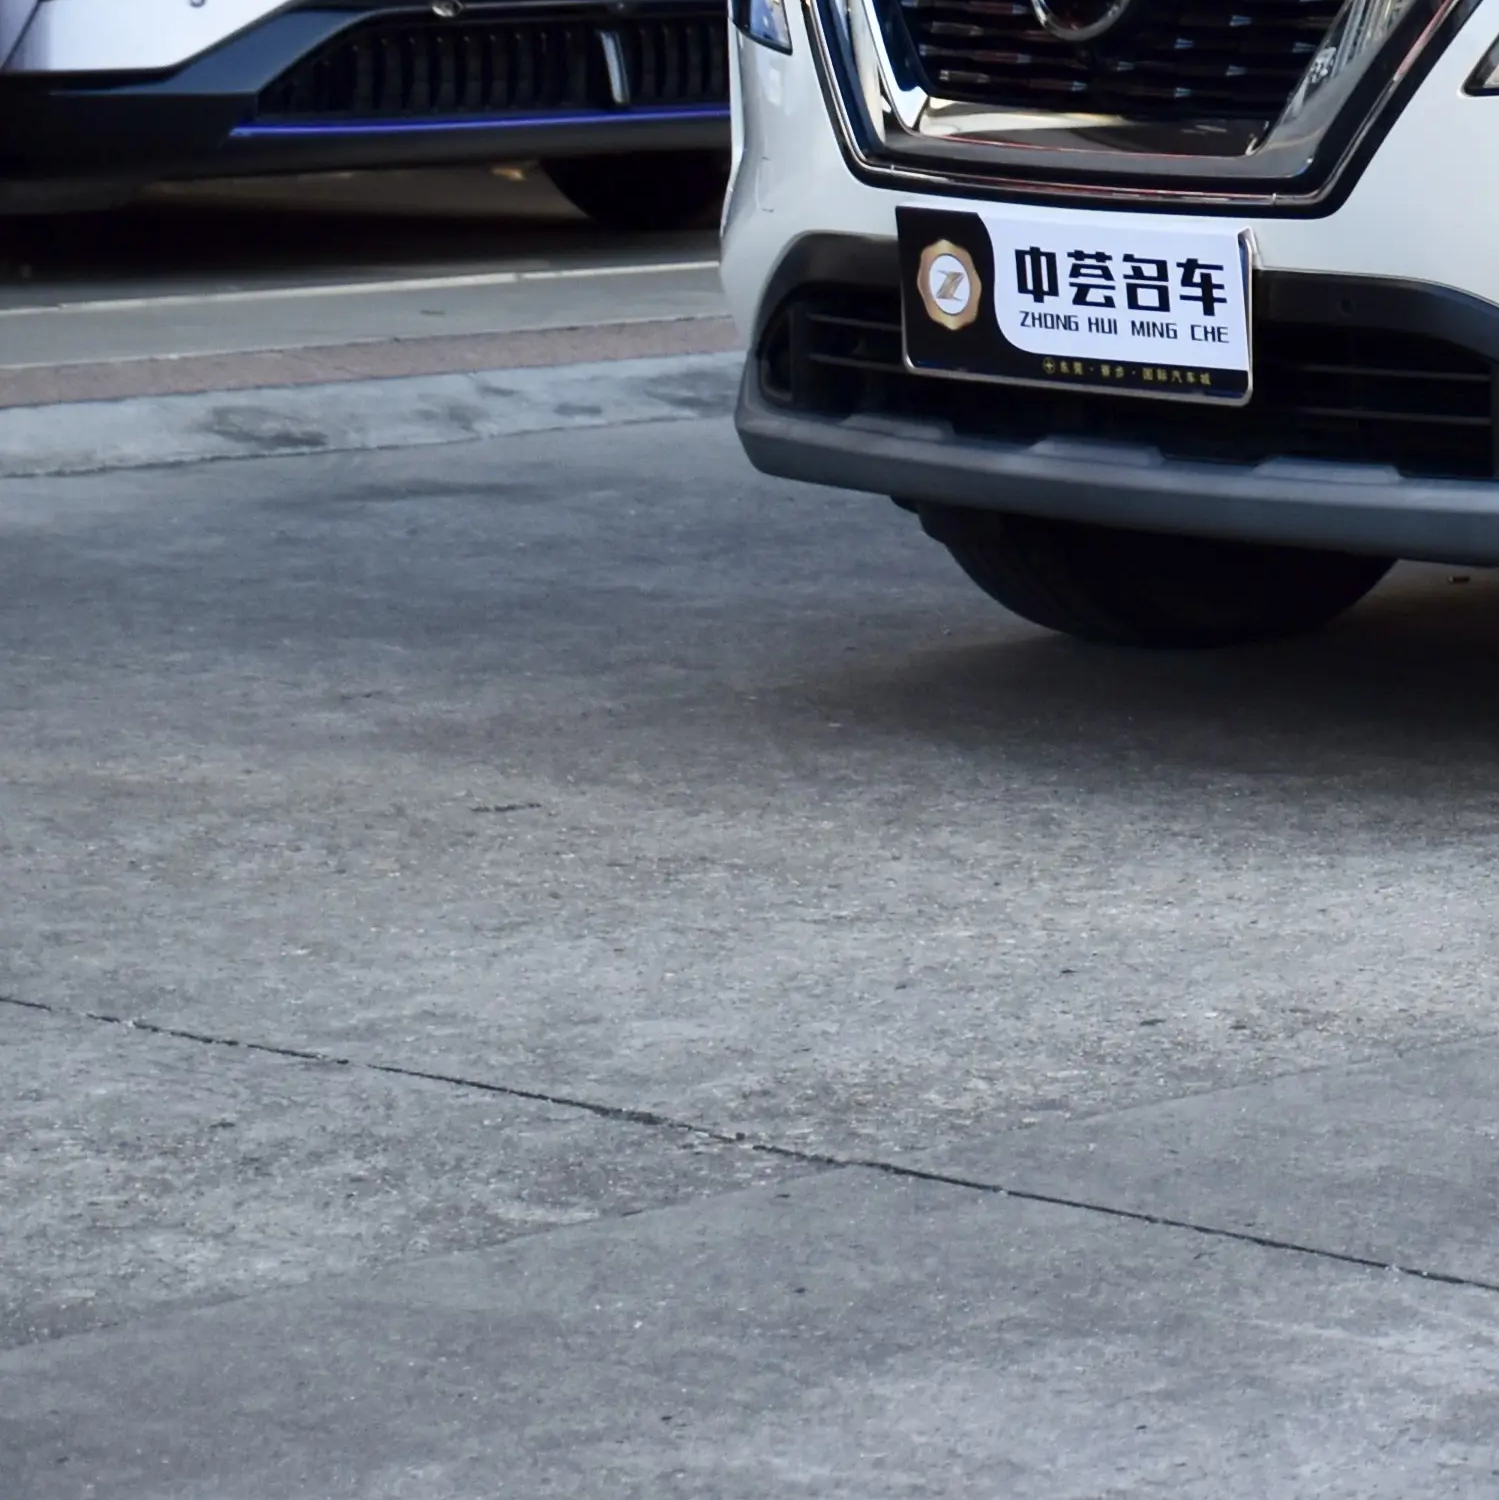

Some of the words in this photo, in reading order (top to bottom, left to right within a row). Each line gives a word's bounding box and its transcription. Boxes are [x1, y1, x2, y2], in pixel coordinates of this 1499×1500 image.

[1015, 246, 1228, 317] 中荟名车
[1019, 310, 1080, 332] ZHONG
[1088, 316, 1118, 335] HUI
[1130, 320, 1179, 340] MING
[1190, 324, 1230, 344] CHE
